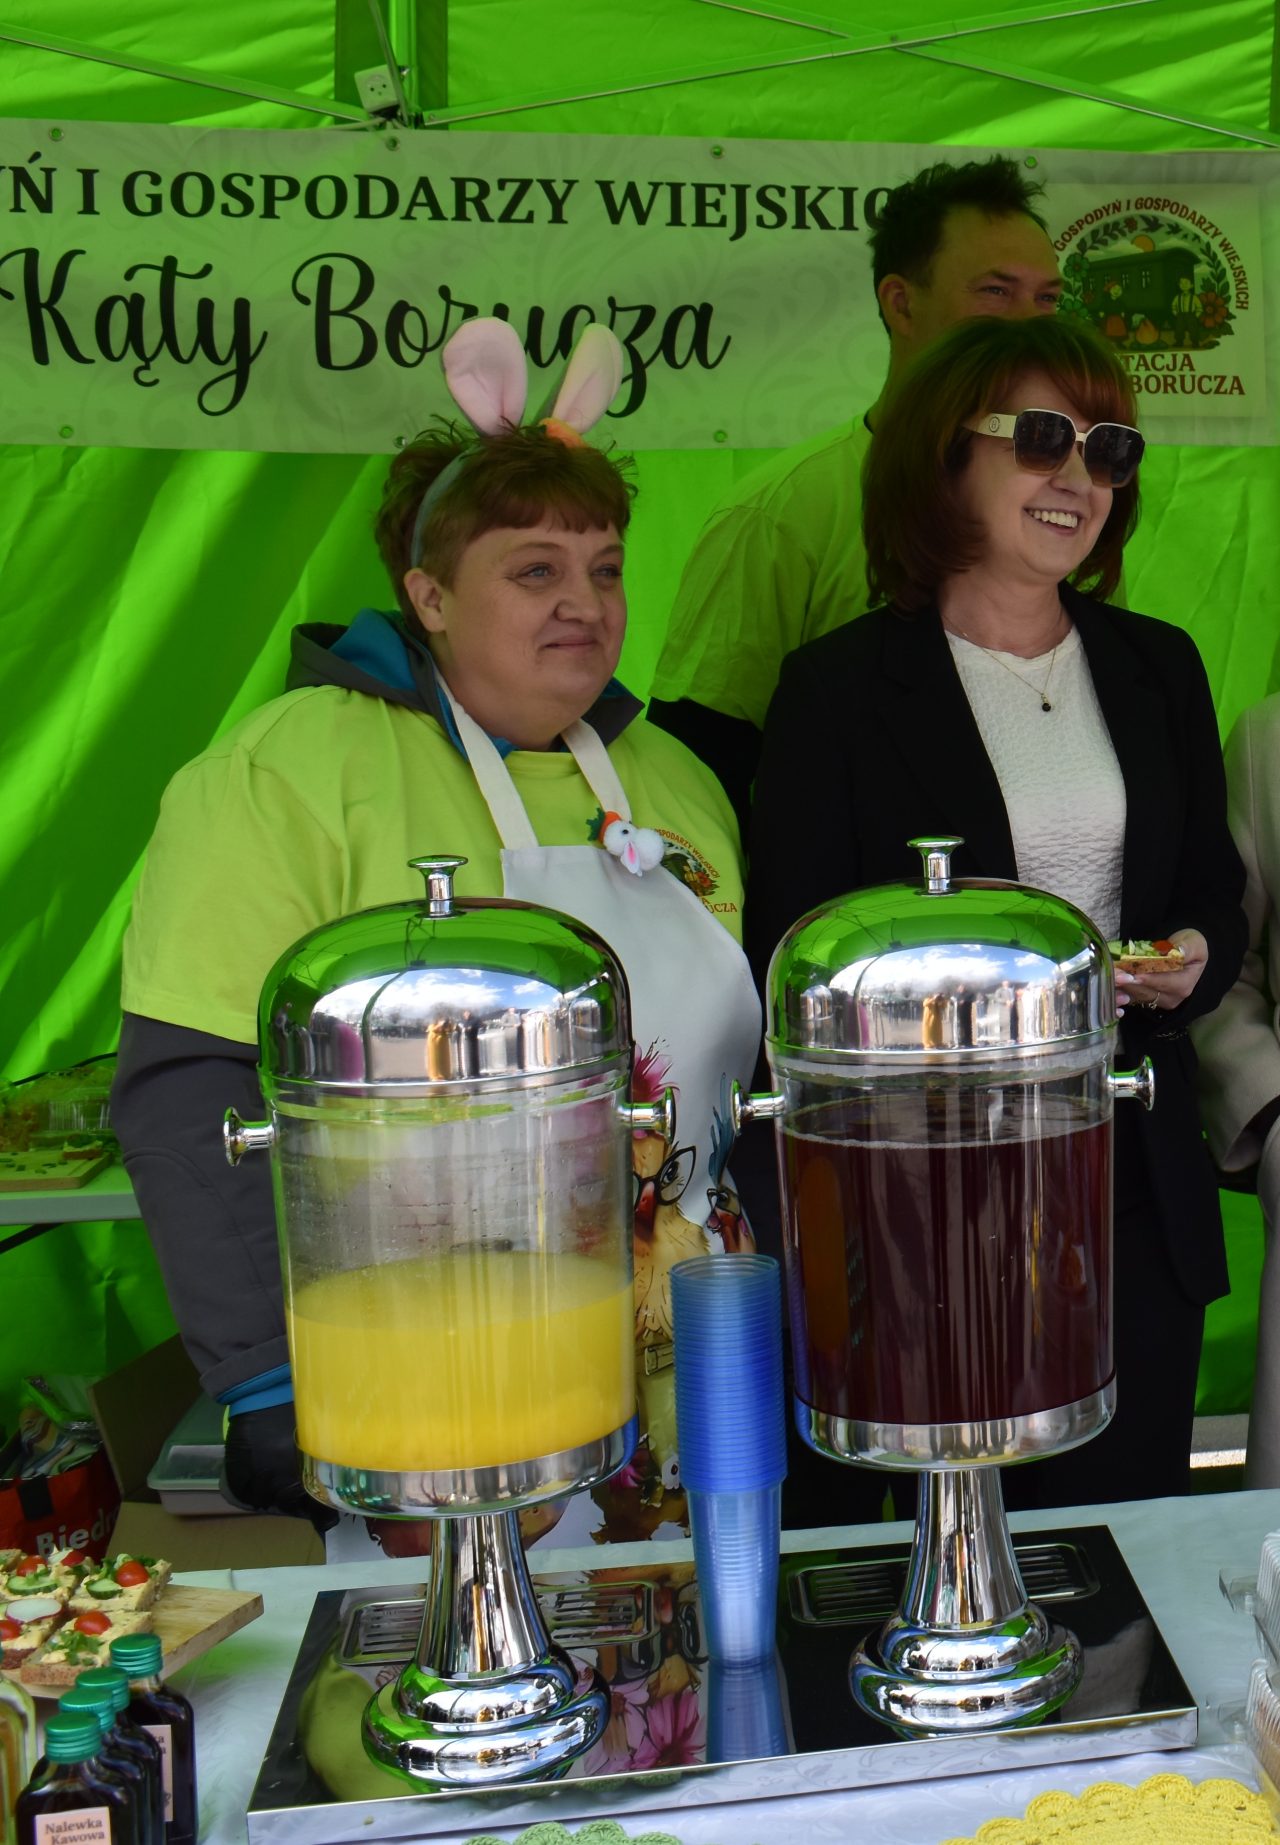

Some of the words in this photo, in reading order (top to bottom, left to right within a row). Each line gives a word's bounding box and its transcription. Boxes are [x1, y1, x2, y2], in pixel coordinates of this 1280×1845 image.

[76, 168, 100, 215] I
[122, 169, 579, 226] GOSPODARZY
[595, 179, 894, 241] WIEJSKIC
[1053, 199, 1122, 252] GOSPODYŃ
[1134, 196, 1223, 240] GOSPODARZY
[1218, 237, 1250, 311] WIEJSKICH
[0, 247, 267, 417] Kąty
[1120, 353, 1196, 372] TACJA
[45, 1818, 103, 1834] Nalewka
[51, 1829, 105, 1845] Kawowa
